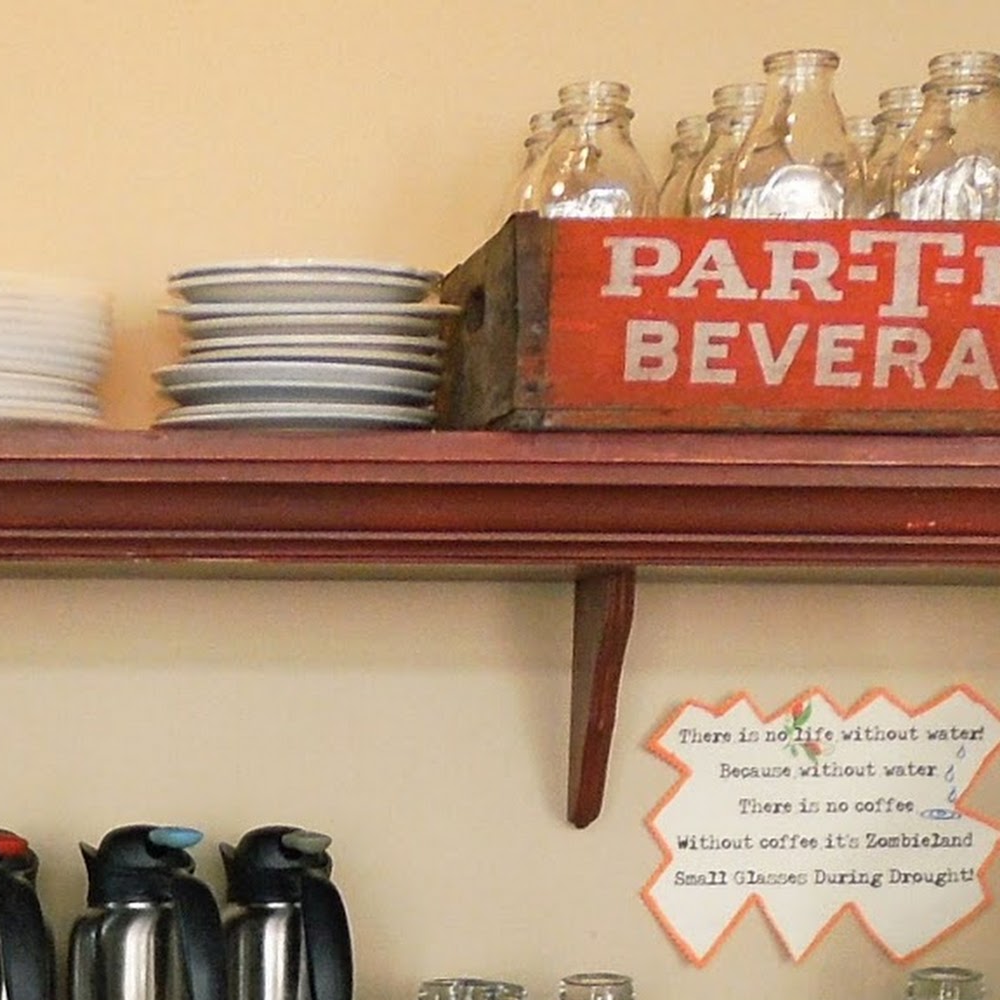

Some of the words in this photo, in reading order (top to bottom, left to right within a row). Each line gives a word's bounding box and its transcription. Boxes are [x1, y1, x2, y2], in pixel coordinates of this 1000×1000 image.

[679, 728, 731, 743] There
[739, 727, 759, 742] is
[765, 730, 787, 742] no
[794, 728, 834, 741] life
[841, 727, 919, 741] without
[927, 727, 984, 741] water!
[720, 763, 791, 779] Because
[798, 763, 876, 777] without
[884, 764, 938, 777] water
[739, 800, 792, 814] There
[799, 800, 820, 814] is
[826, 801, 847, 813] no
[855, 799, 914, 813] coffee
[677, 835, 753, 850] Without
[760, 834, 818, 849] coffee
[825, 834, 860, 849] it's
[866, 833, 973, 848] Zombieland
[674, 871, 727, 886] Small
[733, 871, 808, 886] Glasses
[814, 870, 883, 888] During
[889, 868, 974, 887] Drought!
